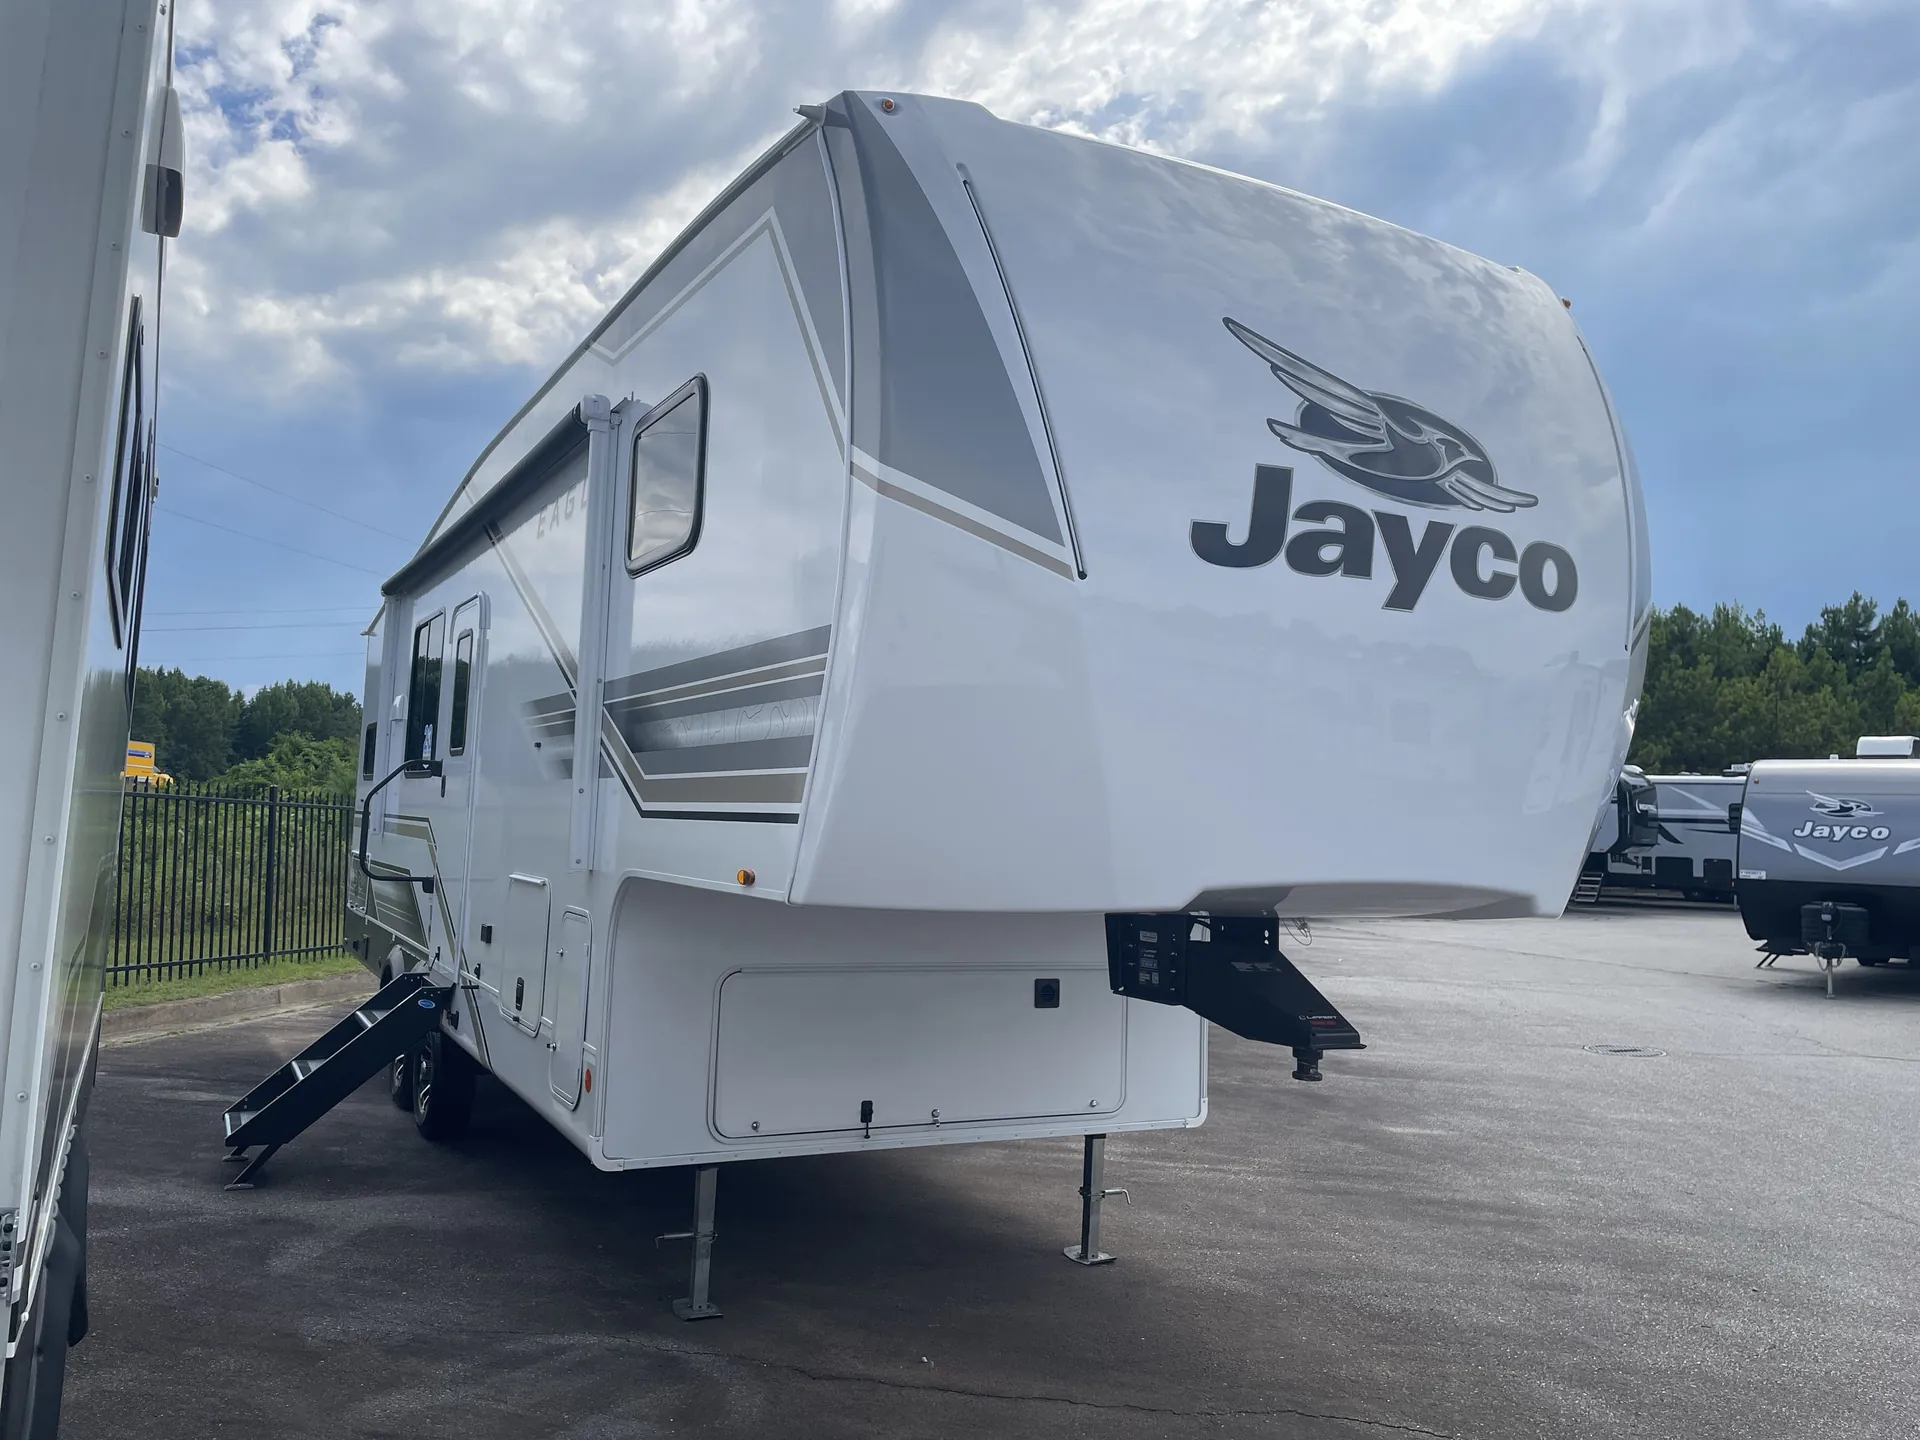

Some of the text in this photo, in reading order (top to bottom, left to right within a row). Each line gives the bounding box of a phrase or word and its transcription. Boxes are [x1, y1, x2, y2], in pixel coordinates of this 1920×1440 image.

[537, 477, 587, 539] EAGL
[1190, 463, 1578, 613] Jayco
[1793, 820, 1891, 842] Jayco
